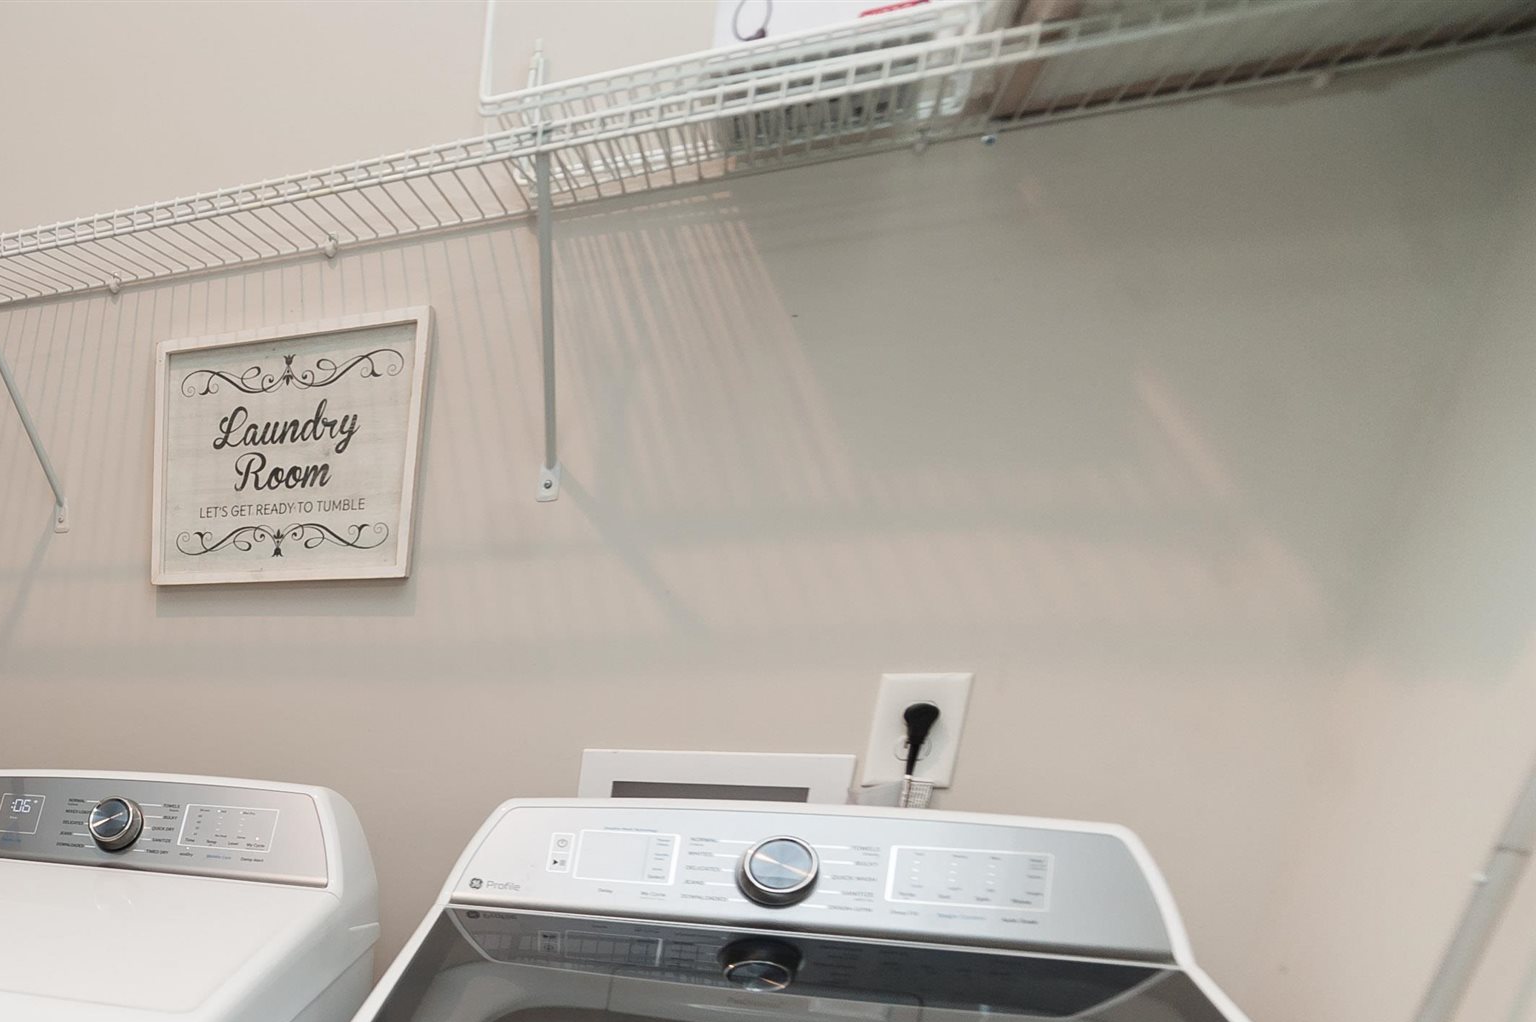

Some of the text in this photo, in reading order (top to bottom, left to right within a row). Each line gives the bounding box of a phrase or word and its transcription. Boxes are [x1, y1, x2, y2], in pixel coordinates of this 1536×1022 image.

[213, 398, 360, 454] Laundry
[234, 452, 332, 492] Room
[199, 498, 366, 519] LET'S GET READY TO TUMBLE
[485, 880, 521, 892] Profile
